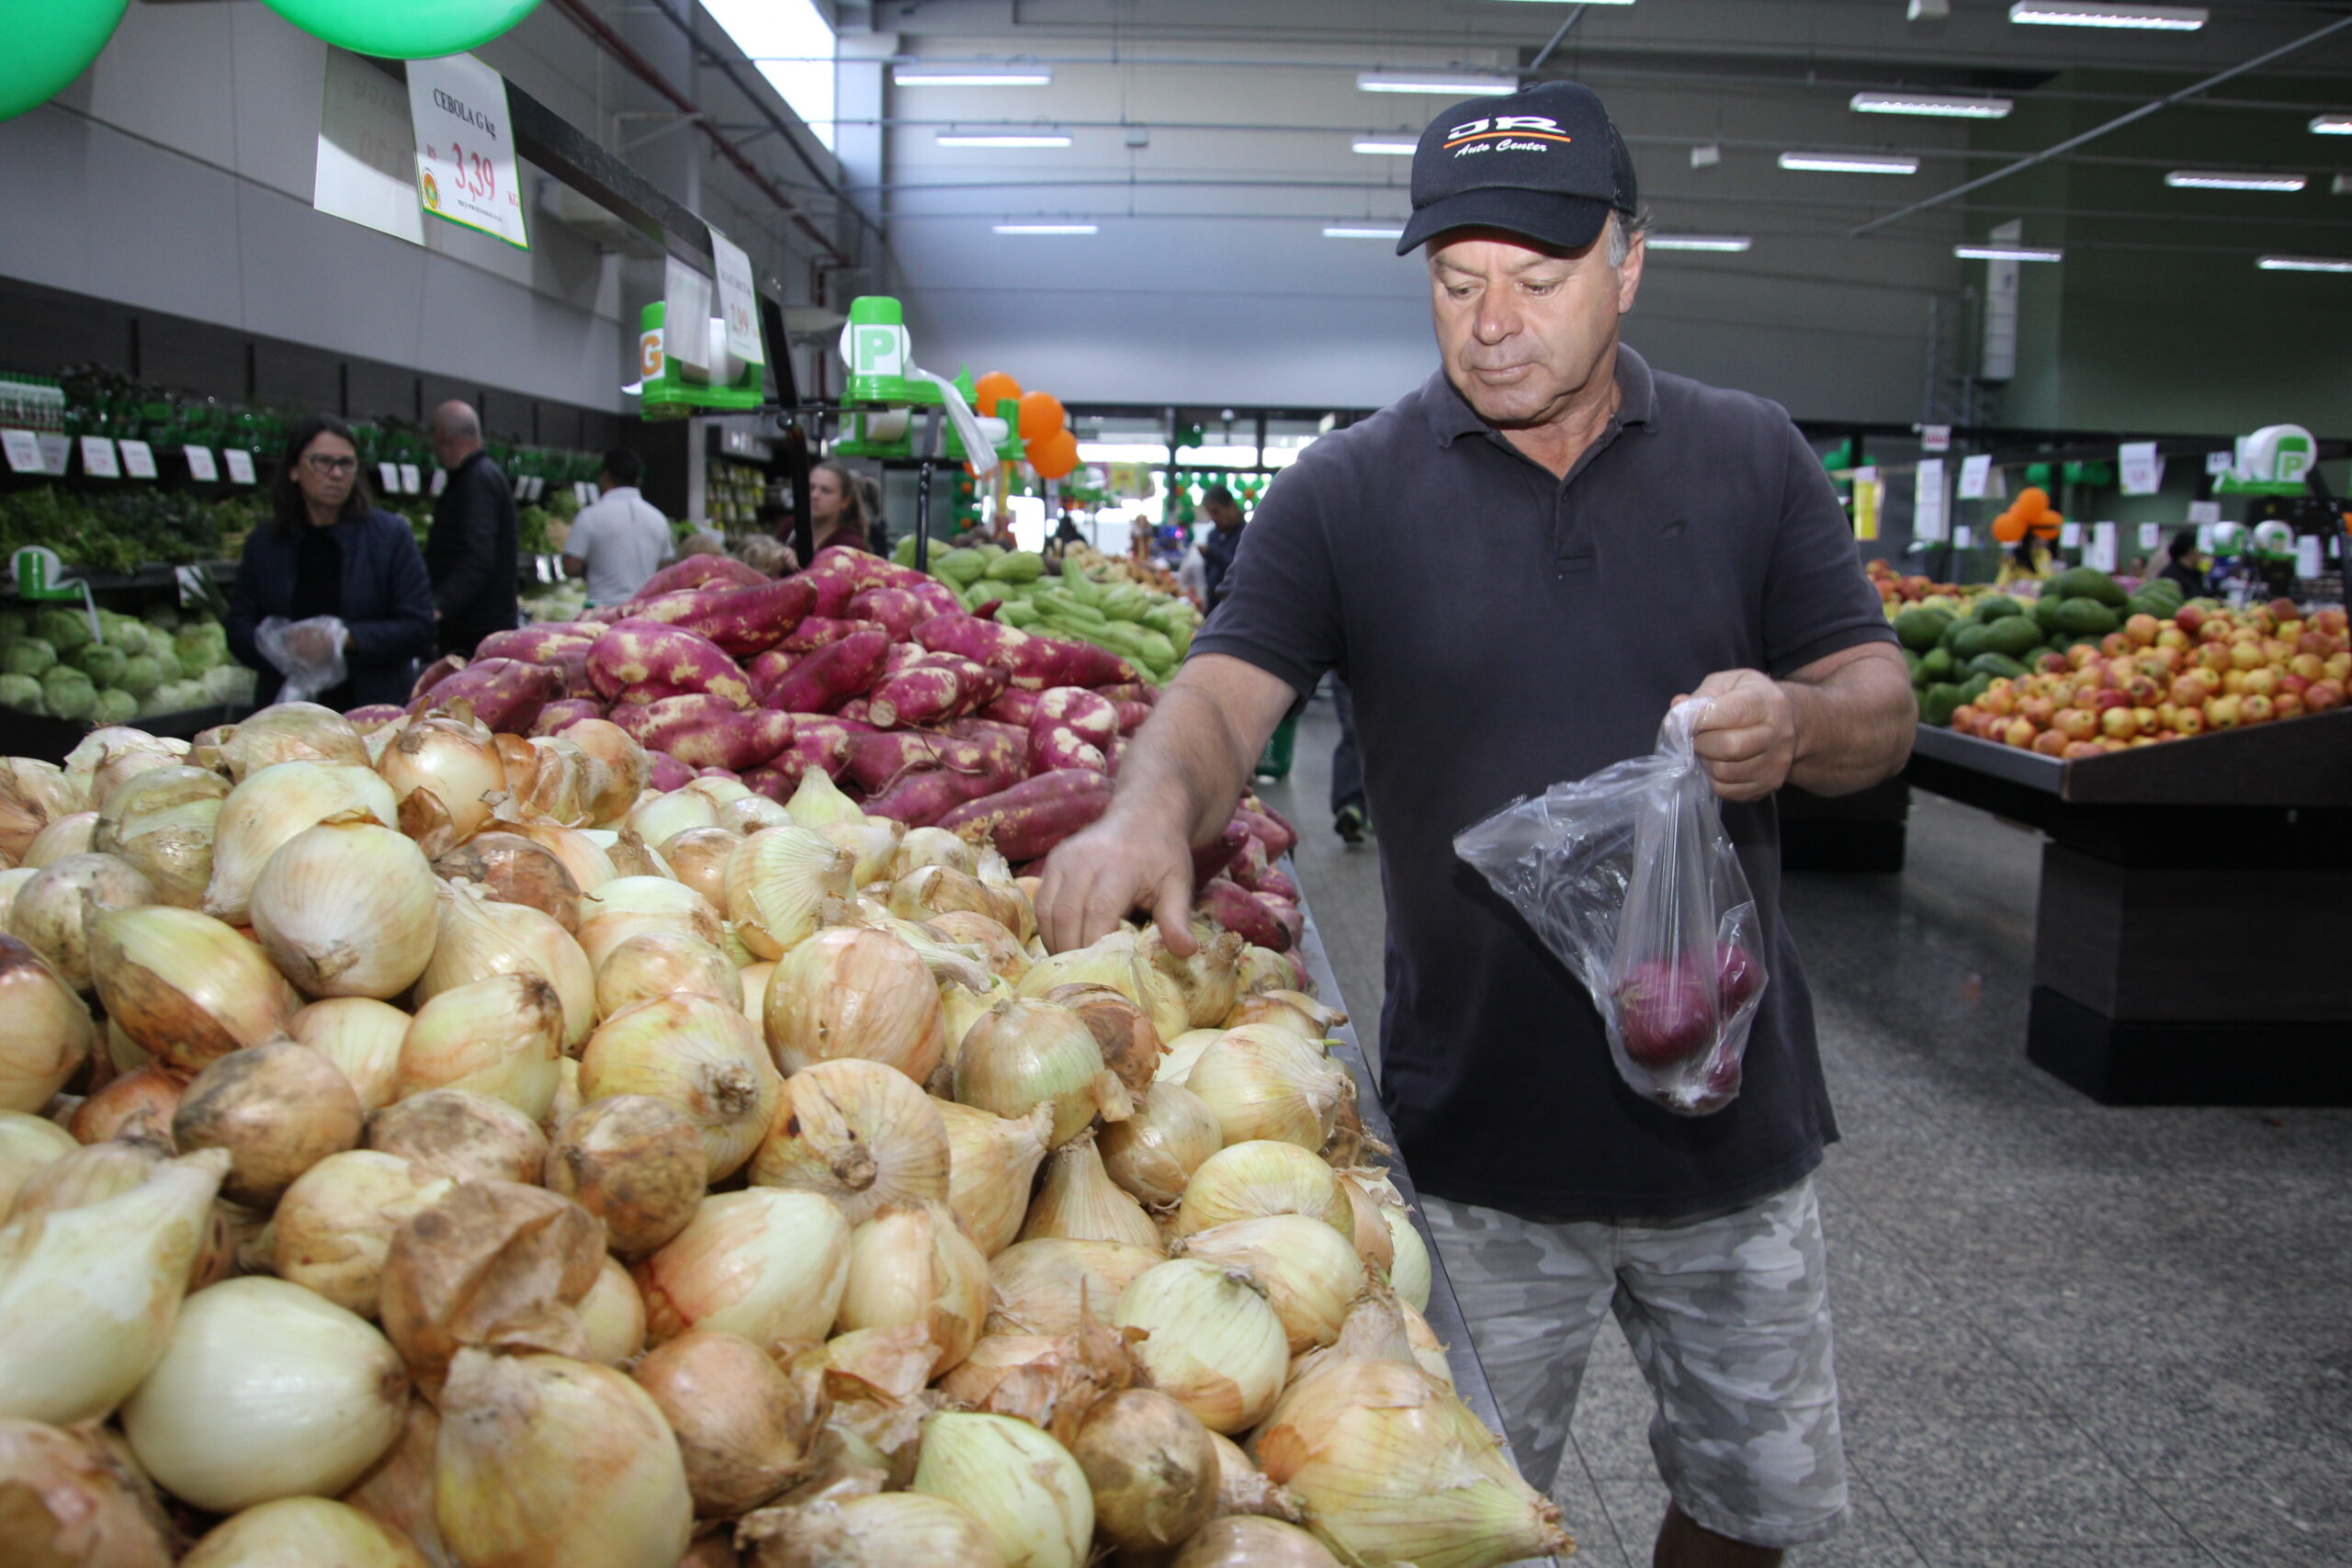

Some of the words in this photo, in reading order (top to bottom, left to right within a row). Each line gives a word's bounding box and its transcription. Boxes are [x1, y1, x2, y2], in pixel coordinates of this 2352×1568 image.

[433, 87, 475, 126] CEBOLA
[475, 110, 484, 130] G
[1454, 143, 1491, 158] Auto
[1495, 139, 1548, 152] Center
[451, 141, 496, 203] 3,39
[639, 334, 662, 377] G
[859, 328, 896, 371] P
[2283, 456, 2304, 478] P
